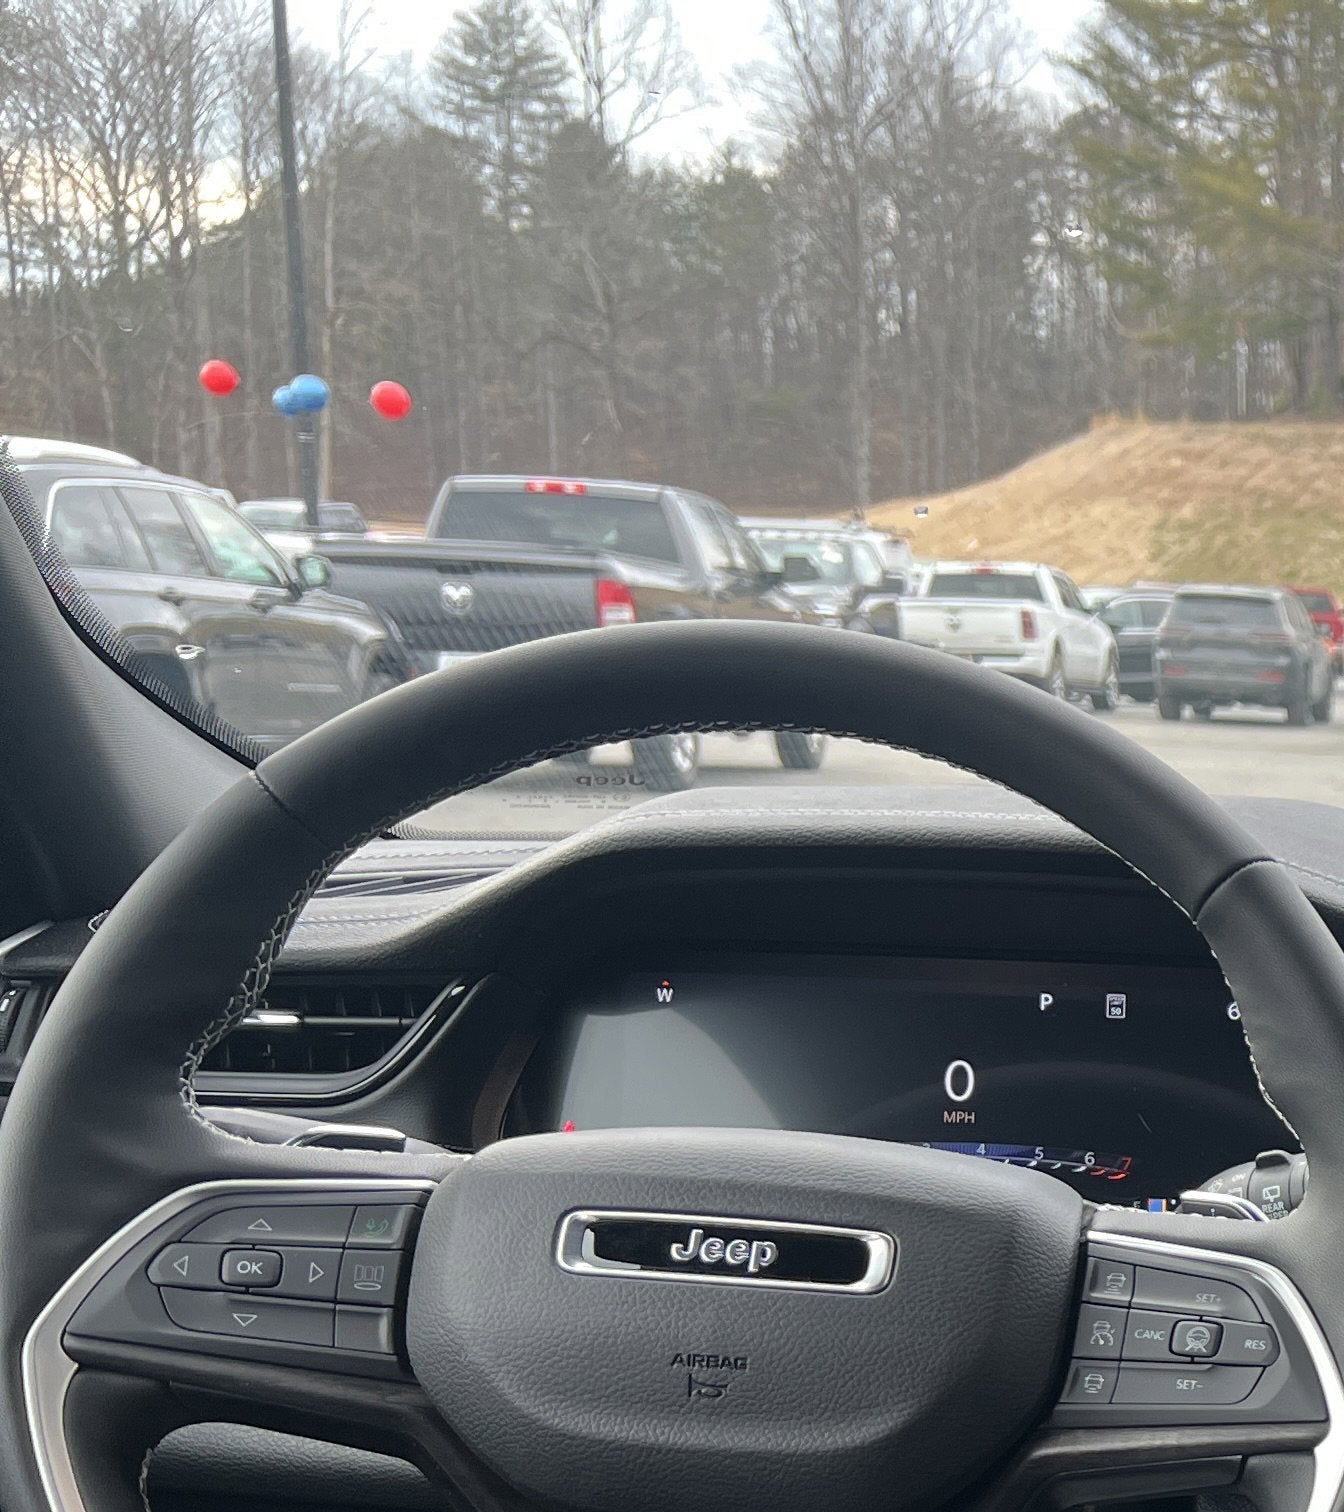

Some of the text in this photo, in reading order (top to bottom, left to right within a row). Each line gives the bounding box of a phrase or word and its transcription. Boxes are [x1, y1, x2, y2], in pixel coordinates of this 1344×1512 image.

[657, 987, 674, 1003] W
[1038, 993, 1053, 1011] P
[944, 1059, 975, 1102] 0
[943, 1111, 976, 1125] MPH
[976, 1143, 1134, 1172] 4 5 6 7
[1231, 1173, 1247, 1183] ON
[1261, 1201, 1285, 1214] REAR
[670, 1228, 779, 1273] Jeep
[237, 1260, 263, 1276] OK
[1195, 1293, 1222, 1304] SET+
[1134, 1328, 1167, 1342] CANC
[1244, 1338, 1267, 1351] RES
[670, 1353, 749, 1371] AIRBAG
